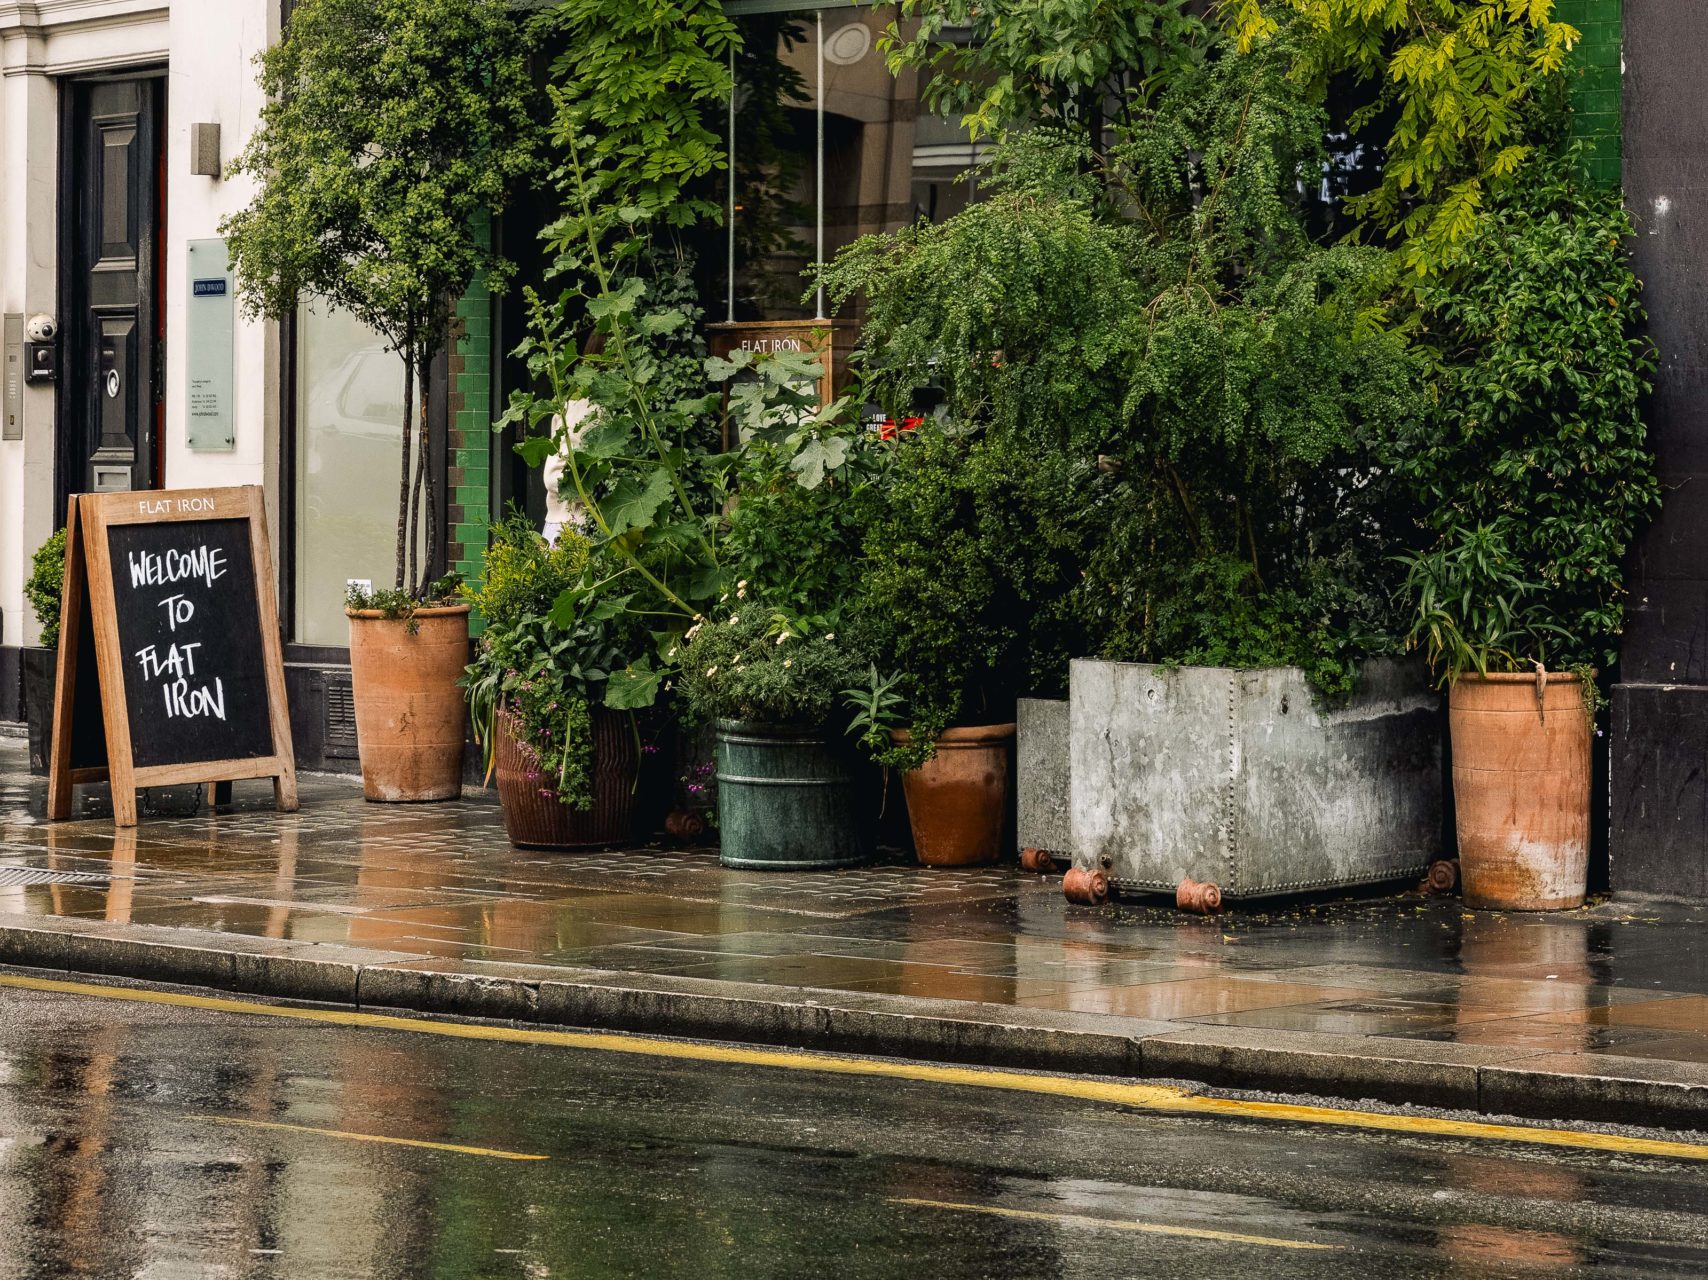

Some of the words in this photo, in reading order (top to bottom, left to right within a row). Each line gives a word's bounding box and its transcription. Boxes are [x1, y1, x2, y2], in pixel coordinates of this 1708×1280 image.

[741, 339, 768, 353] FLAT
[771, 338, 800, 353] IRON
[139, 499, 172, 514] FLAT
[178, 497, 215, 512] IRON
[128, 545, 227, 589] WELCOME
[158, 593, 195, 632] TO
[135, 642, 202, 681] FLAT
[162, 676, 227, 721] IRON
